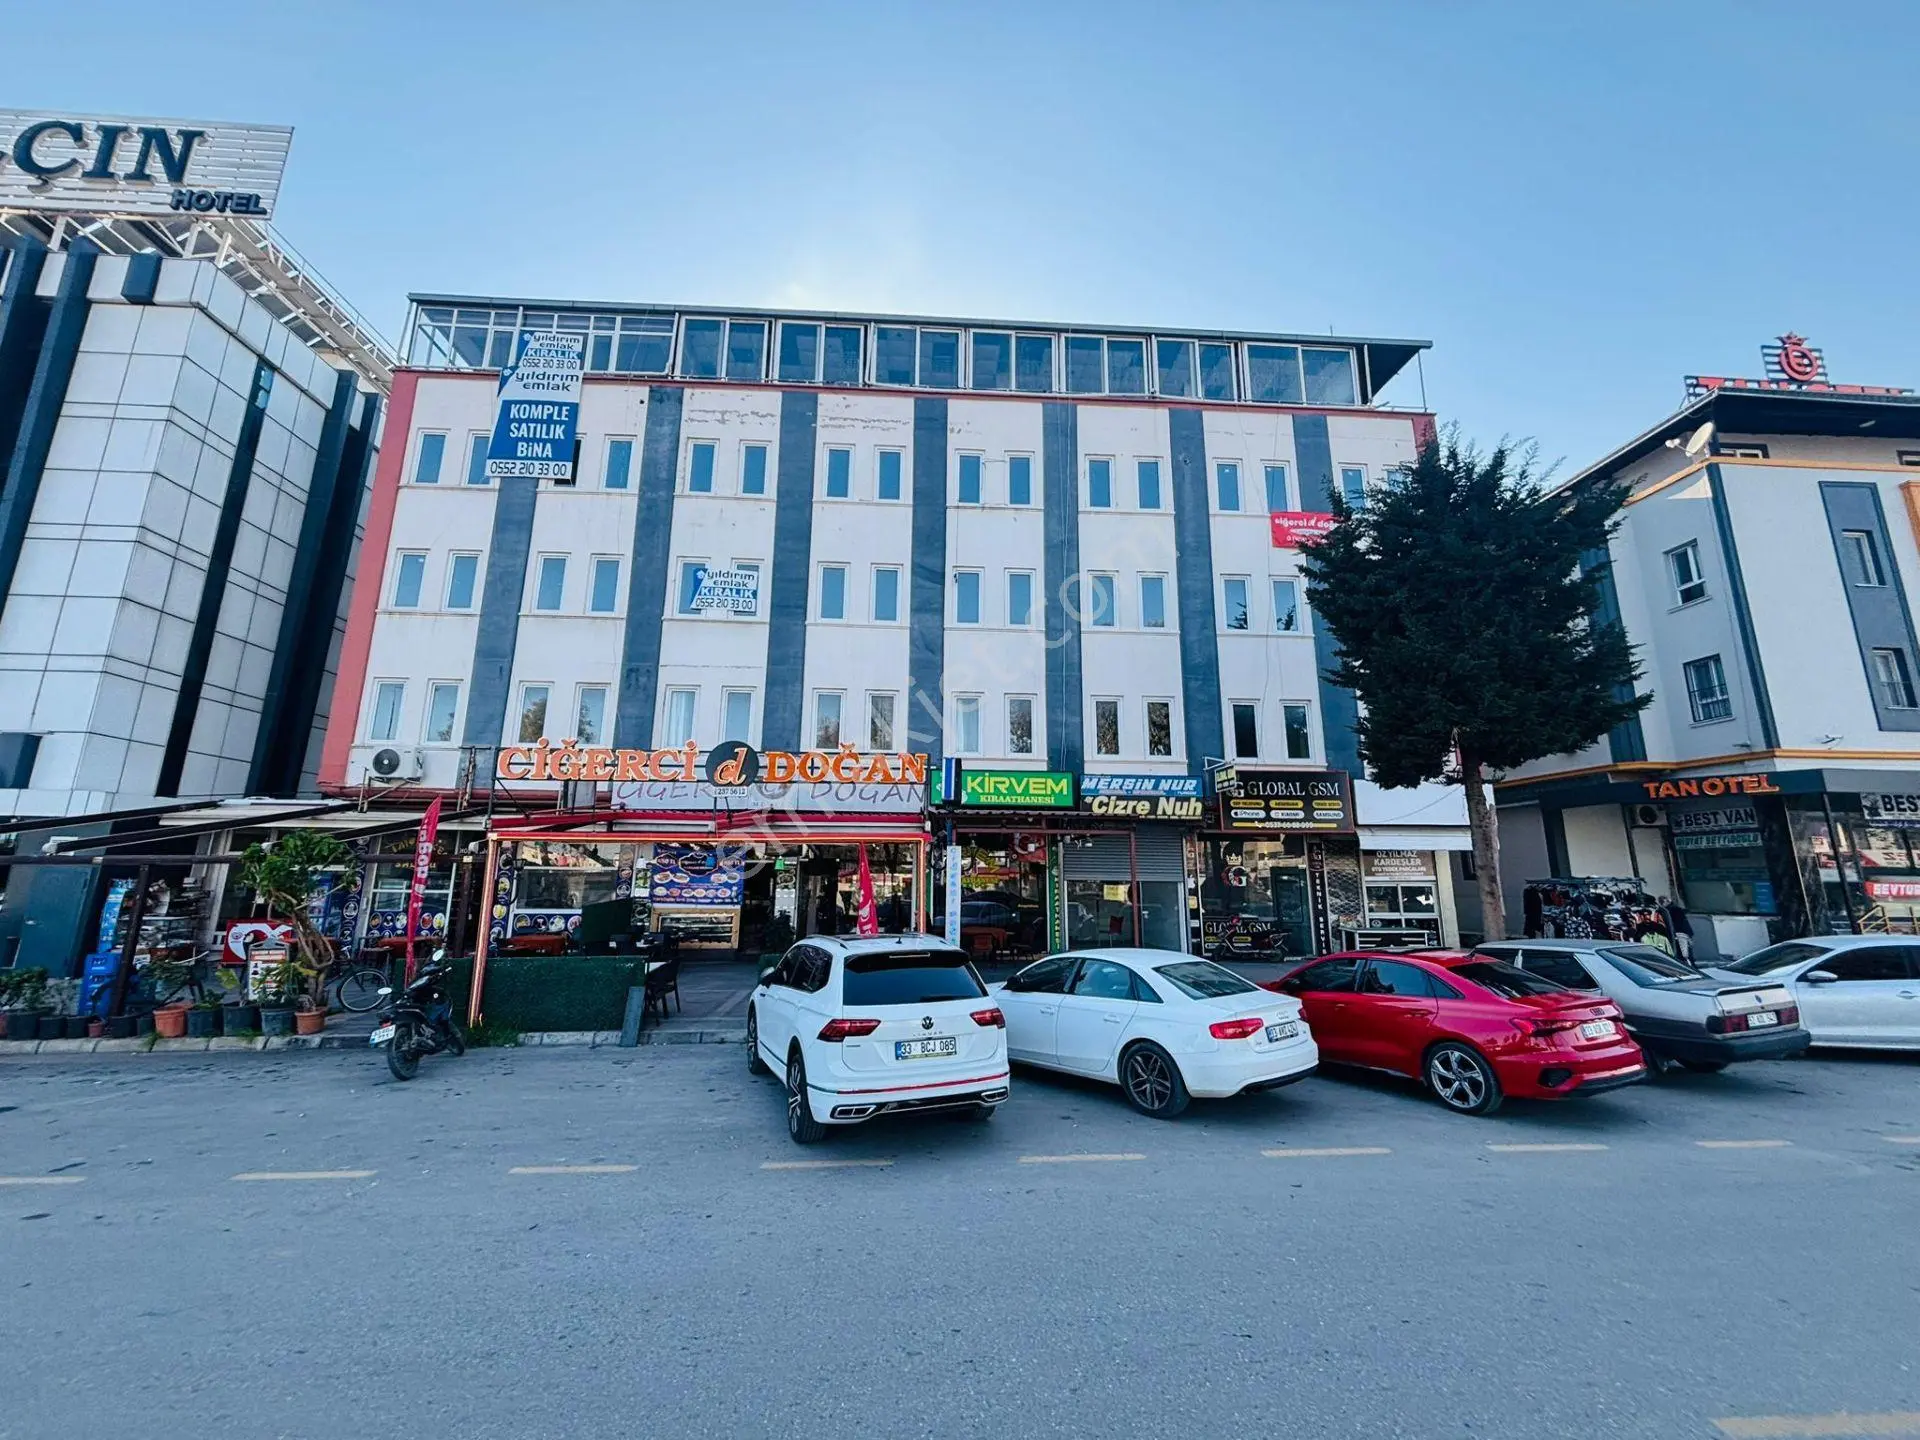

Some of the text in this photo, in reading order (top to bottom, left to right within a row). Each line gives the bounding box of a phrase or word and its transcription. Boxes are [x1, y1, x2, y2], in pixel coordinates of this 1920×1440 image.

[0, 121, 205, 192] ÇIN
[170, 189, 267, 215] HOTEL
[540, 342, 574, 350] emlak
[522, 358, 577, 370] 0552 210 33 00
[515, 371, 579, 383] yıldırım
[523, 382, 571, 392] emlak
[510, 404, 570, 421] KOMPLE
[510, 423, 565, 439] SATILIK
[490, 461, 567, 476] 0552 210 33 00
[707, 570, 754, 580] yıldırım
[713, 579, 749, 588] emlak
[695, 597, 753, 610] 0552 210 33 00
[499, 737, 700, 782] CİĞERCİ
[762, 742, 928, 785] DOĞAN
[966, 772, 1068, 796] KİRVEM
[1159, 779, 1198, 791] NUR
[1247, 781, 1340, 797] GLOBAL GSM
[1643, 774, 1780, 799] TAN OTEL
[1156, 796, 1203, 816] Nuh
[1684, 807, 1756, 827] BEST VAN
[901, 1039, 955, 1055] 33 BCJ 085
